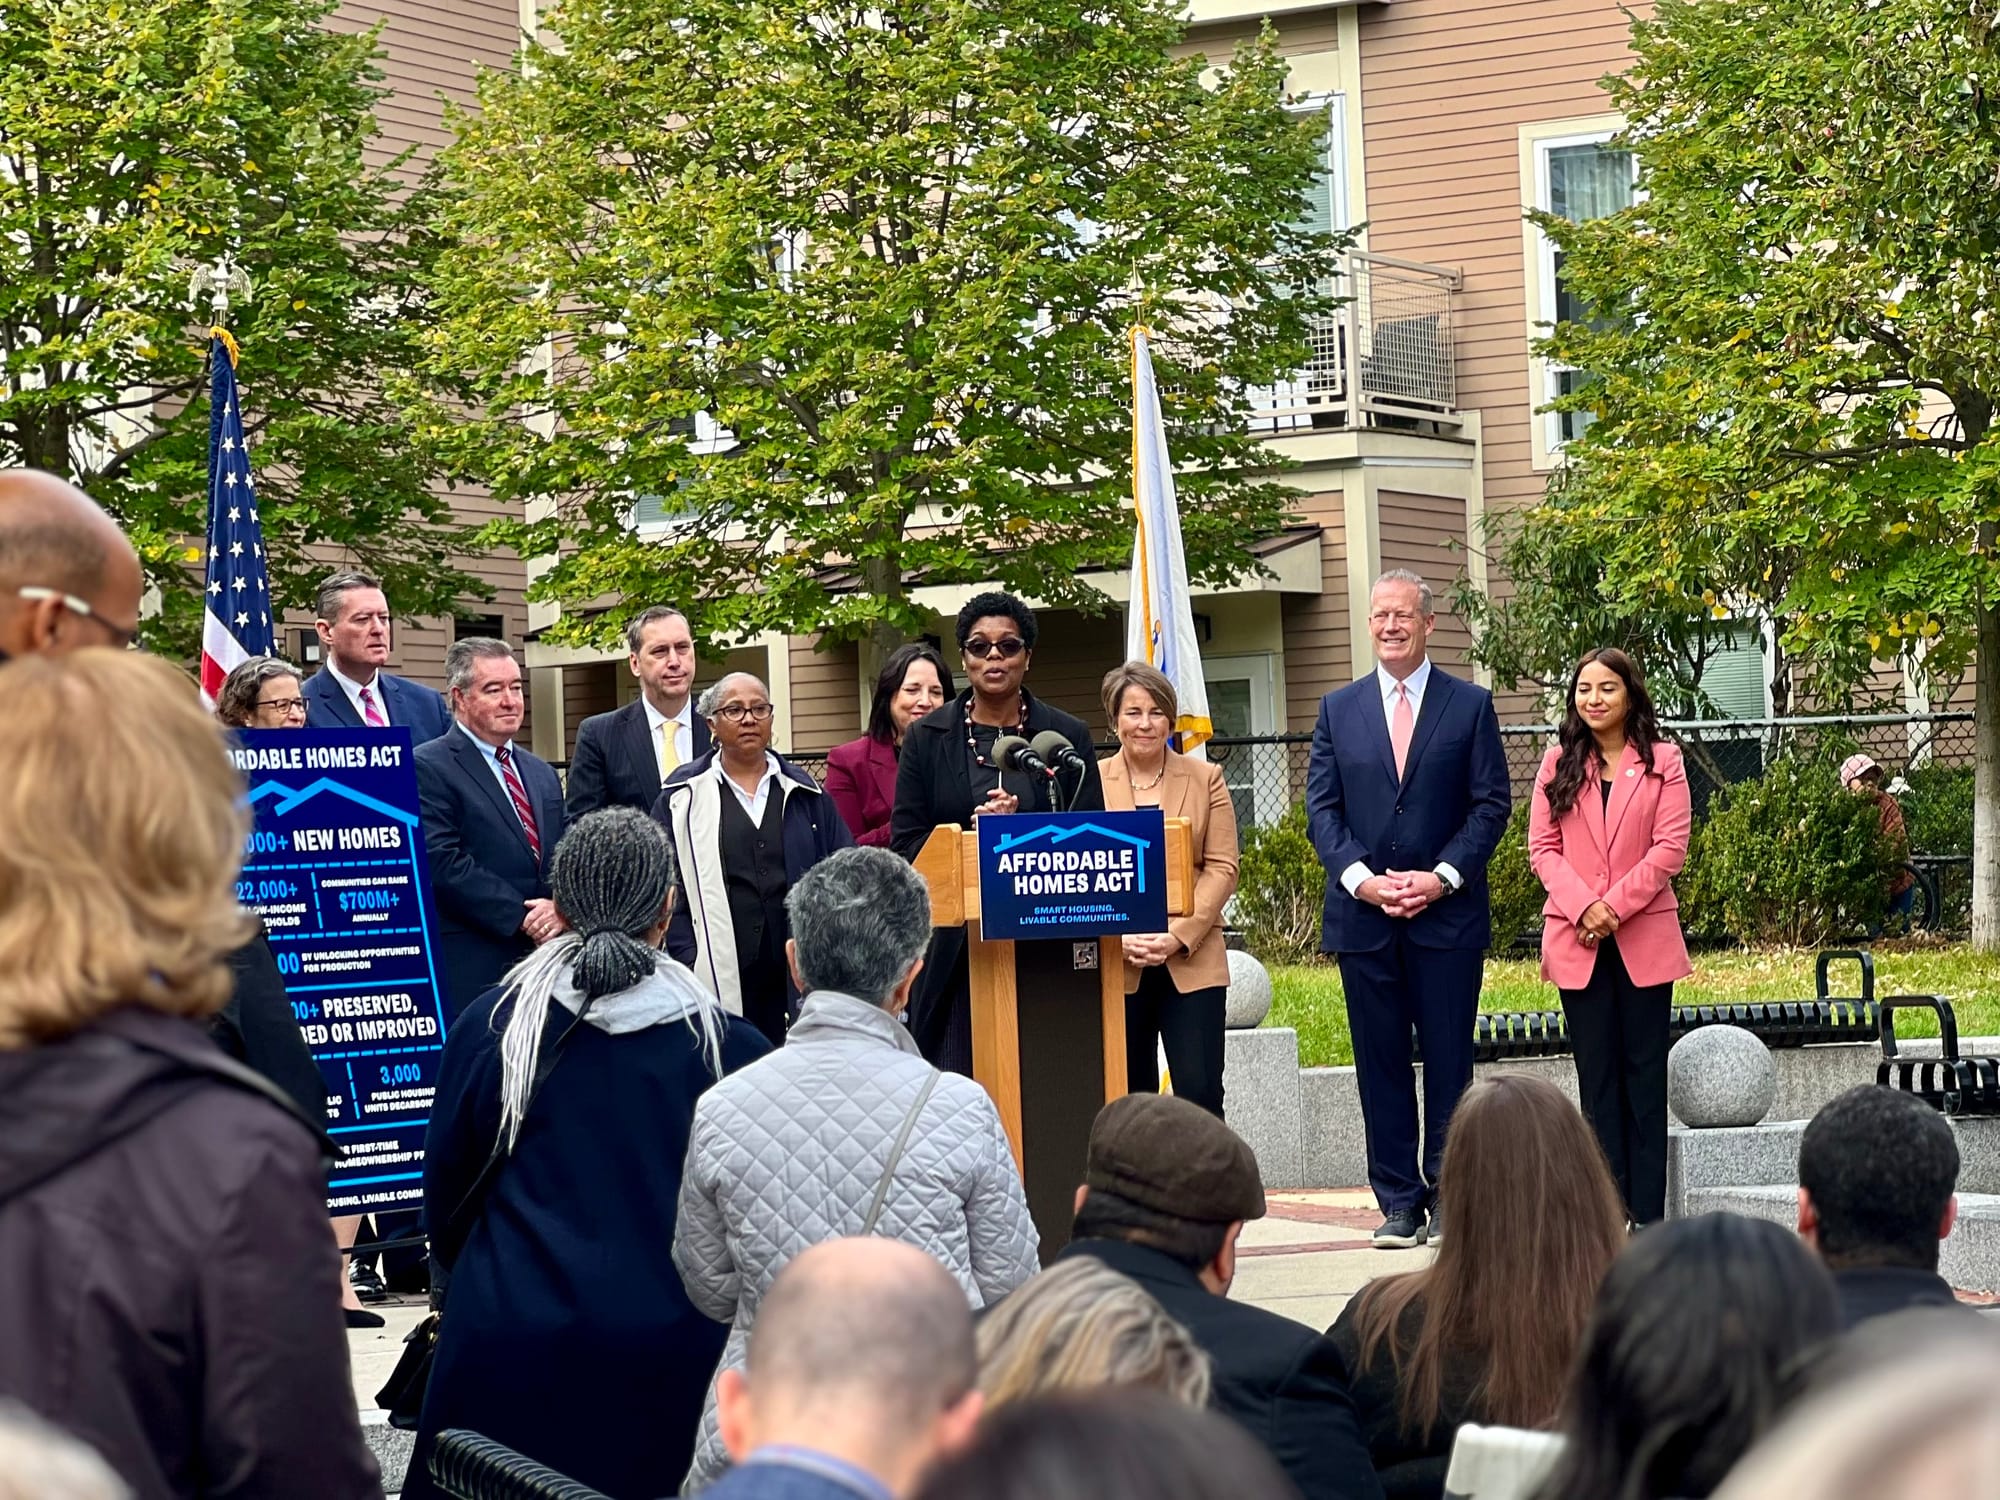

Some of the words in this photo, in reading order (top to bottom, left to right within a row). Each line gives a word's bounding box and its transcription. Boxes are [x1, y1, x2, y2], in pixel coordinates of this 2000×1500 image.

[306, 747, 367, 768] HOMES
[371, 746, 402, 767] ACT
[293, 828, 334, 852] NEW
[338, 826, 401, 850] HOMES
[998, 850, 1134, 874] AFFORDABLE
[321, 877, 371, 888] COMMUNITIES
[1014, 873, 1089, 896] HOMES
[1094, 872, 1134, 892] ACT
[339, 890, 400, 912] $700M+
[352, 912, 389, 922] ANNUALLY
[1034, 906, 1067, 915] SMART
[1068, 904, 1115, 914] HOUSING.
[1020, 916, 1058, 925] LIVABLE
[1060, 913, 1130, 924] COMMUNITIES.
[302, 952, 312, 962] BY
[314, 950, 360, 961] UNLOCKING
[360, 946, 420, 958] OPPORTUNITIES
[304, 964, 320, 974] FOR
[320, 960, 371, 972] PRODUCTION
[322, 994, 418, 1018] PRESERVED,
[332, 1022, 353, 1043] OR
[356, 1016, 437, 1041] IMPROVED
[380, 1063, 421, 1086] 3,000
[371, 1090, 400, 1102] PUBLIC
[364, 1102, 389, 1114] UNITS
[351, 1140, 400, 1154] FIRST-TIME
[362, 1191, 396, 1204] LIVABLE
